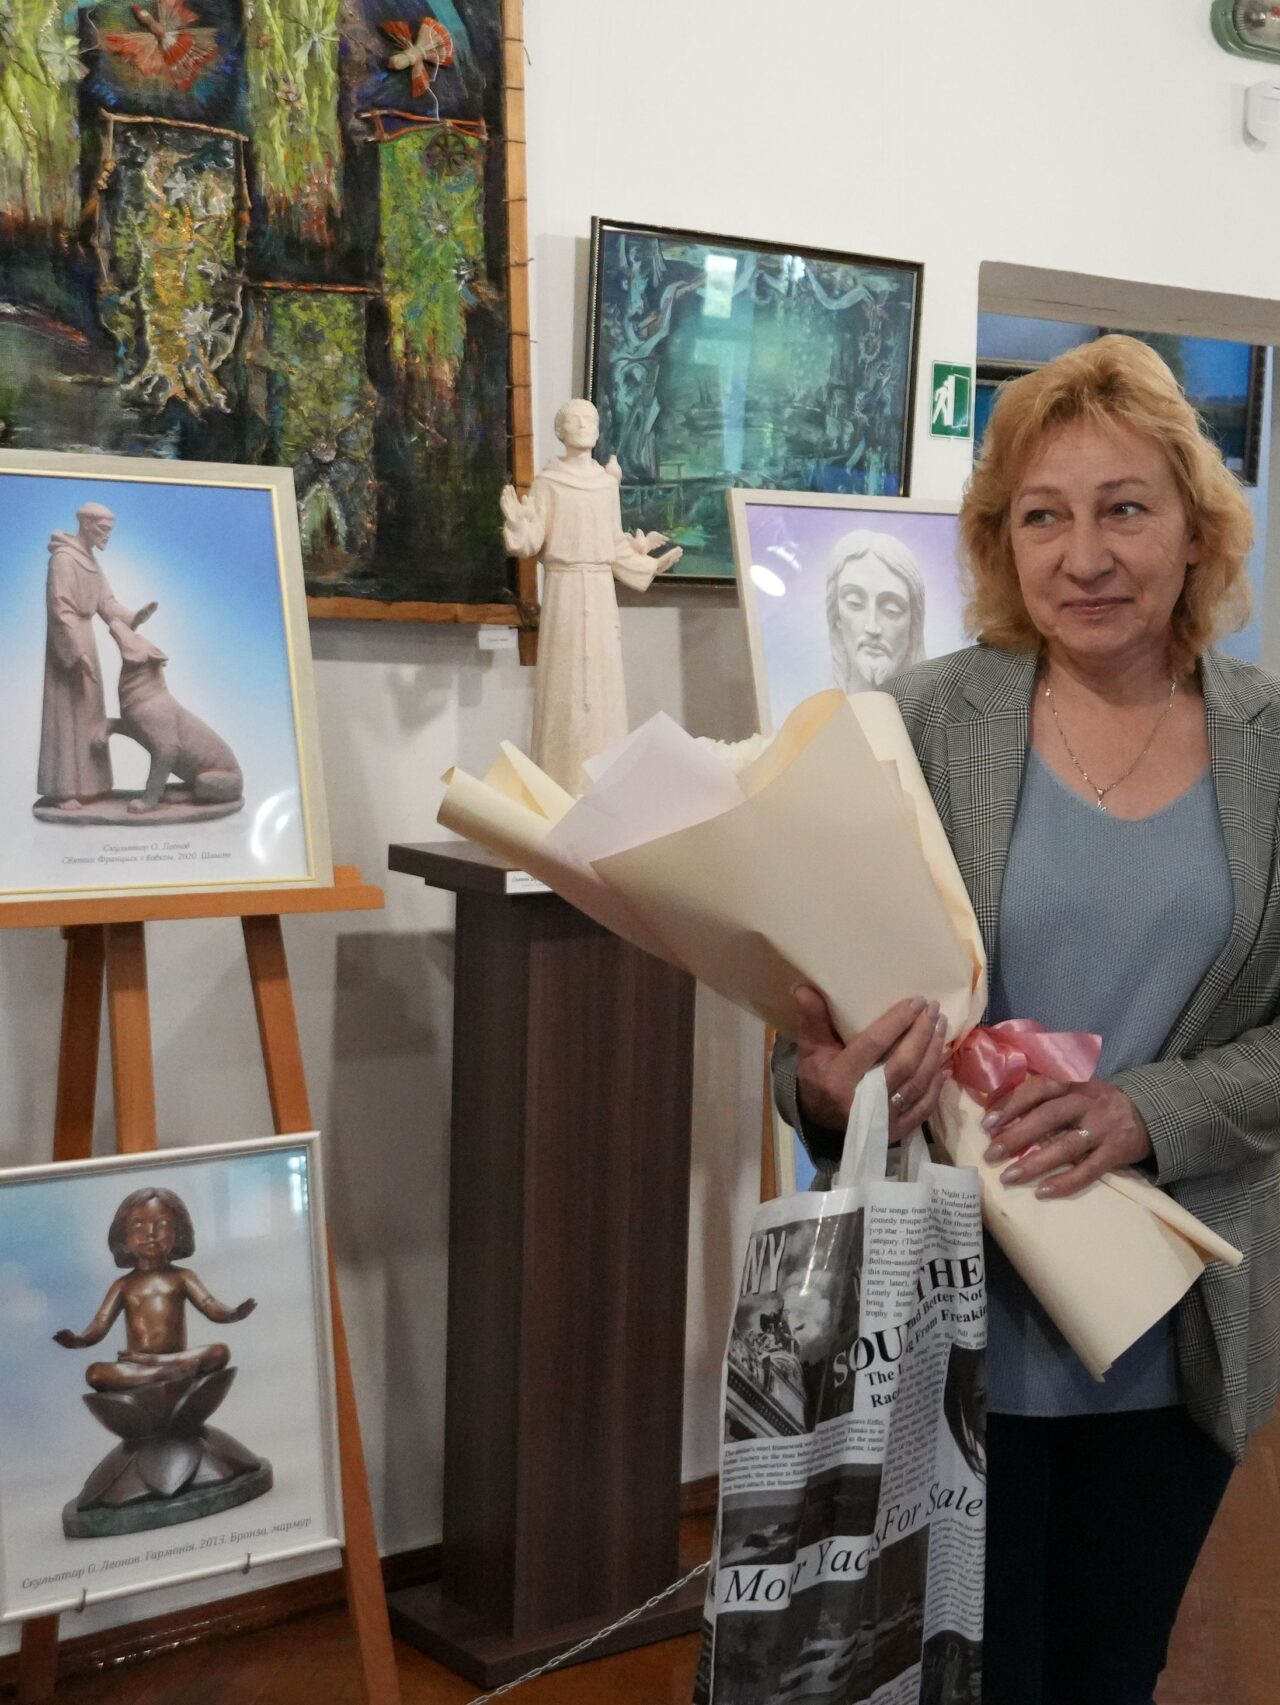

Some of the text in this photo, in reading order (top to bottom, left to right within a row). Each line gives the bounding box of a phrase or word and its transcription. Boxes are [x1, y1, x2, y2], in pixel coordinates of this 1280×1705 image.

[740, 1230, 787, 1297] NY
[865, 1370, 895, 1387] The
[959, 1288, 983, 1304] Not
[914, 1316, 938, 1344] From
[881, 1502, 922, 1542] For
[925, 1483, 984, 1518] Sale
